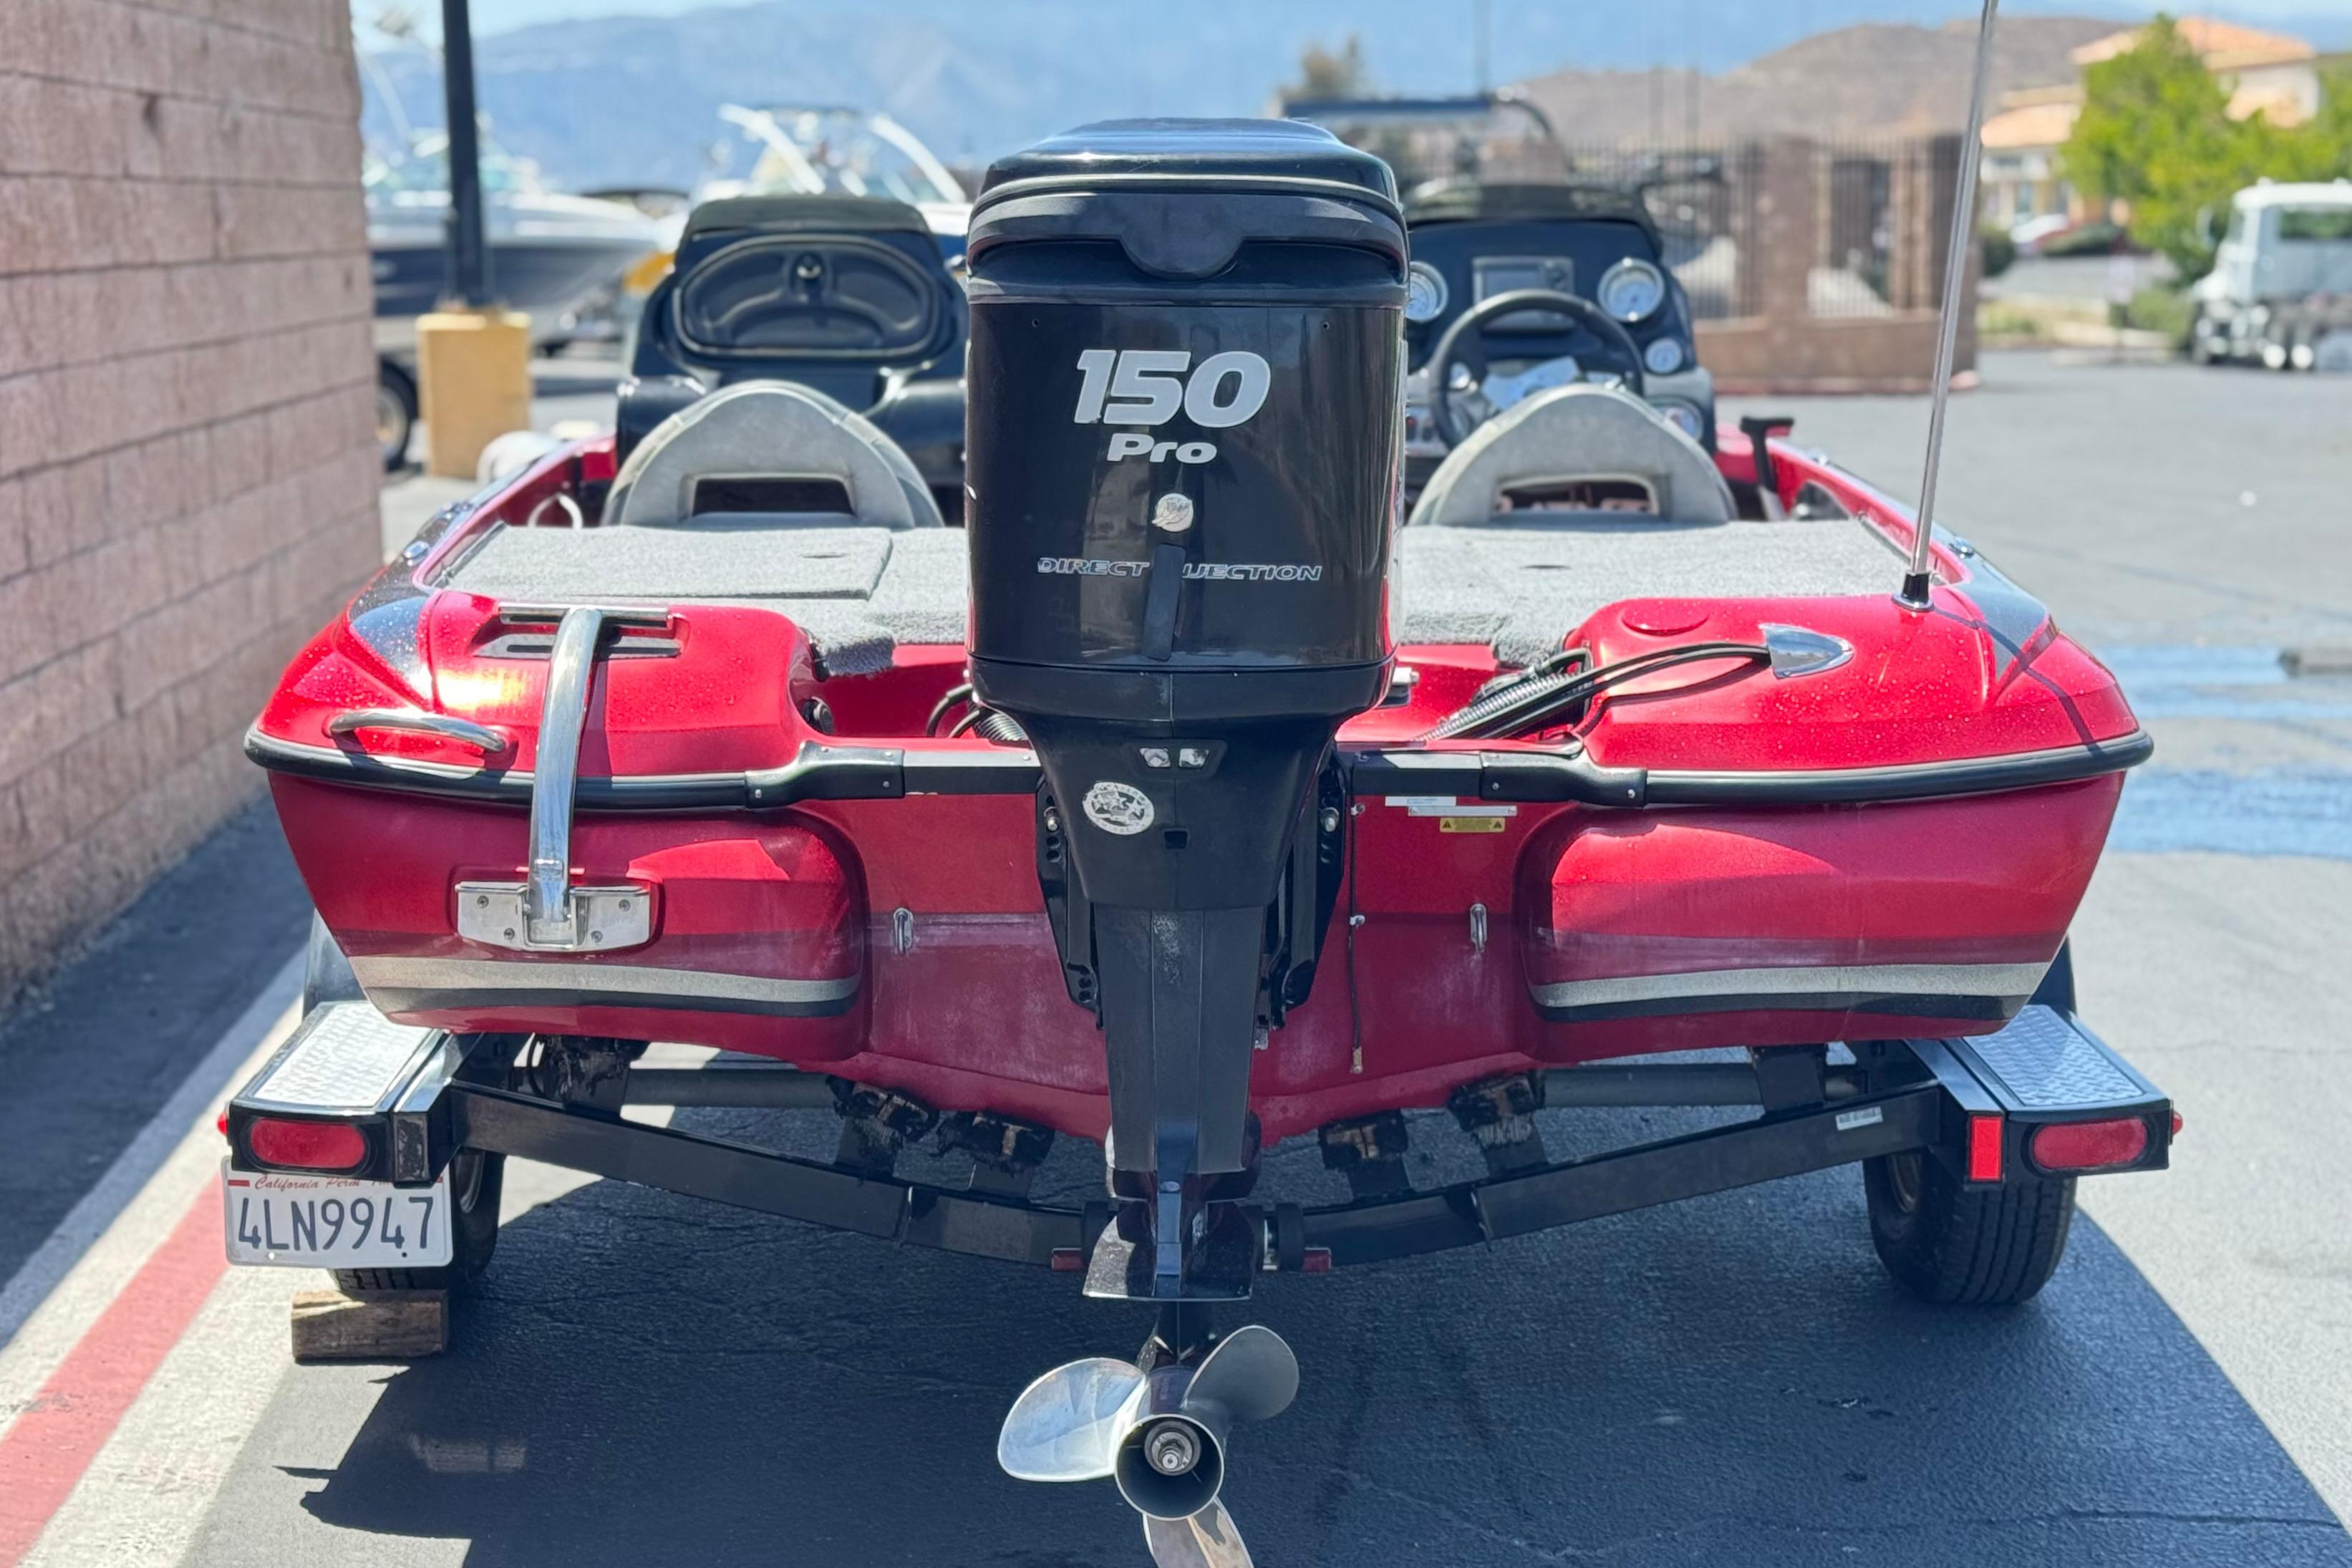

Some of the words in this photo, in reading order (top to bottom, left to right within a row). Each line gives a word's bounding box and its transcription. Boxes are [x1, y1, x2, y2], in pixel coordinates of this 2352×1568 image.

[1074, 349, 1271, 428] 150
[1106, 433, 1217, 464] Pro
[1037, 557, 1151, 577] DIRECT
[1181, 563, 1322, 581] JECTION
[254, 1175, 319, 1193] California
[238, 1196, 434, 1252] 4LN9947
